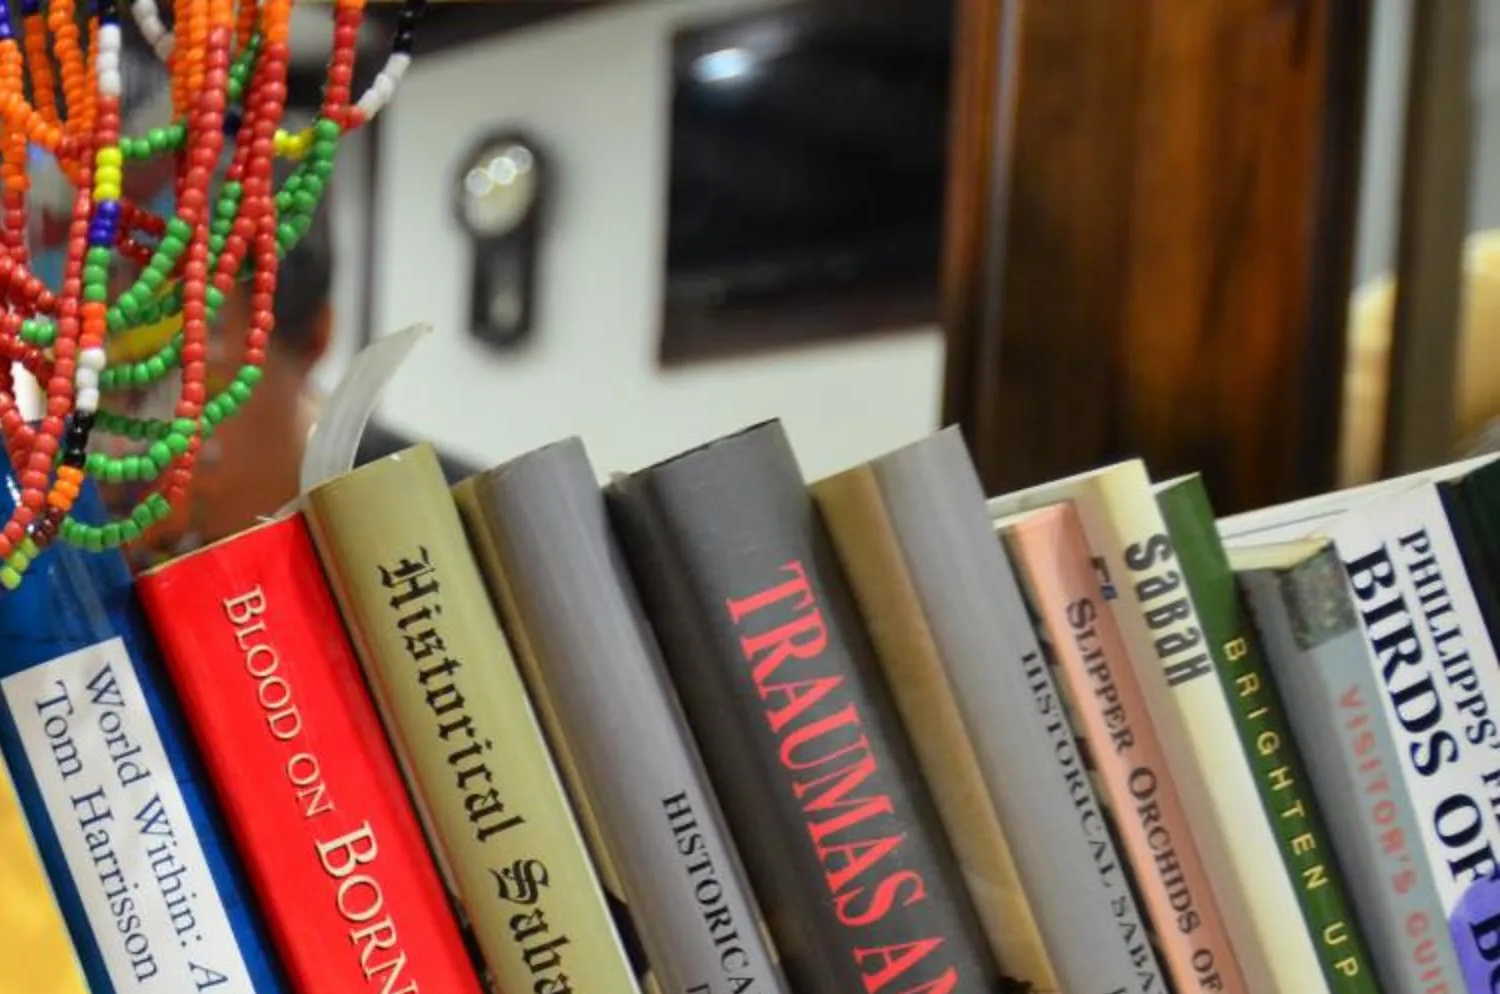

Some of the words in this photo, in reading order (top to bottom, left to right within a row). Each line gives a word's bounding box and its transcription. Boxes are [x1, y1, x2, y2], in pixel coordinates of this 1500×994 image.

[34, 680, 83, 780] Tom
[71, 786, 160, 983] Harrisson
[85, 663, 150, 788] World
[132, 793, 204, 948] Within:
[188, 961, 228, 994] A
[223, 586, 303, 742] BLOOD
[286, 752, 334, 818] ON
[377, 547, 526, 844] Historical
[726, 560, 928, 927] TRAUMAS
[1022, 651, 1113, 891] HISTORICAL
[1066, 597, 1138, 755] SLIPPER
[1128, 766, 1202, 935] ORCHIDS
[1223, 637, 1329, 890] BRIGHTEN
[1323, 922, 1359, 977] UP
[1339, 685, 1417, 894] VISITOR'S
[1345, 541, 1459, 777] BIRDS
[1434, 794, 1500, 882] OF
